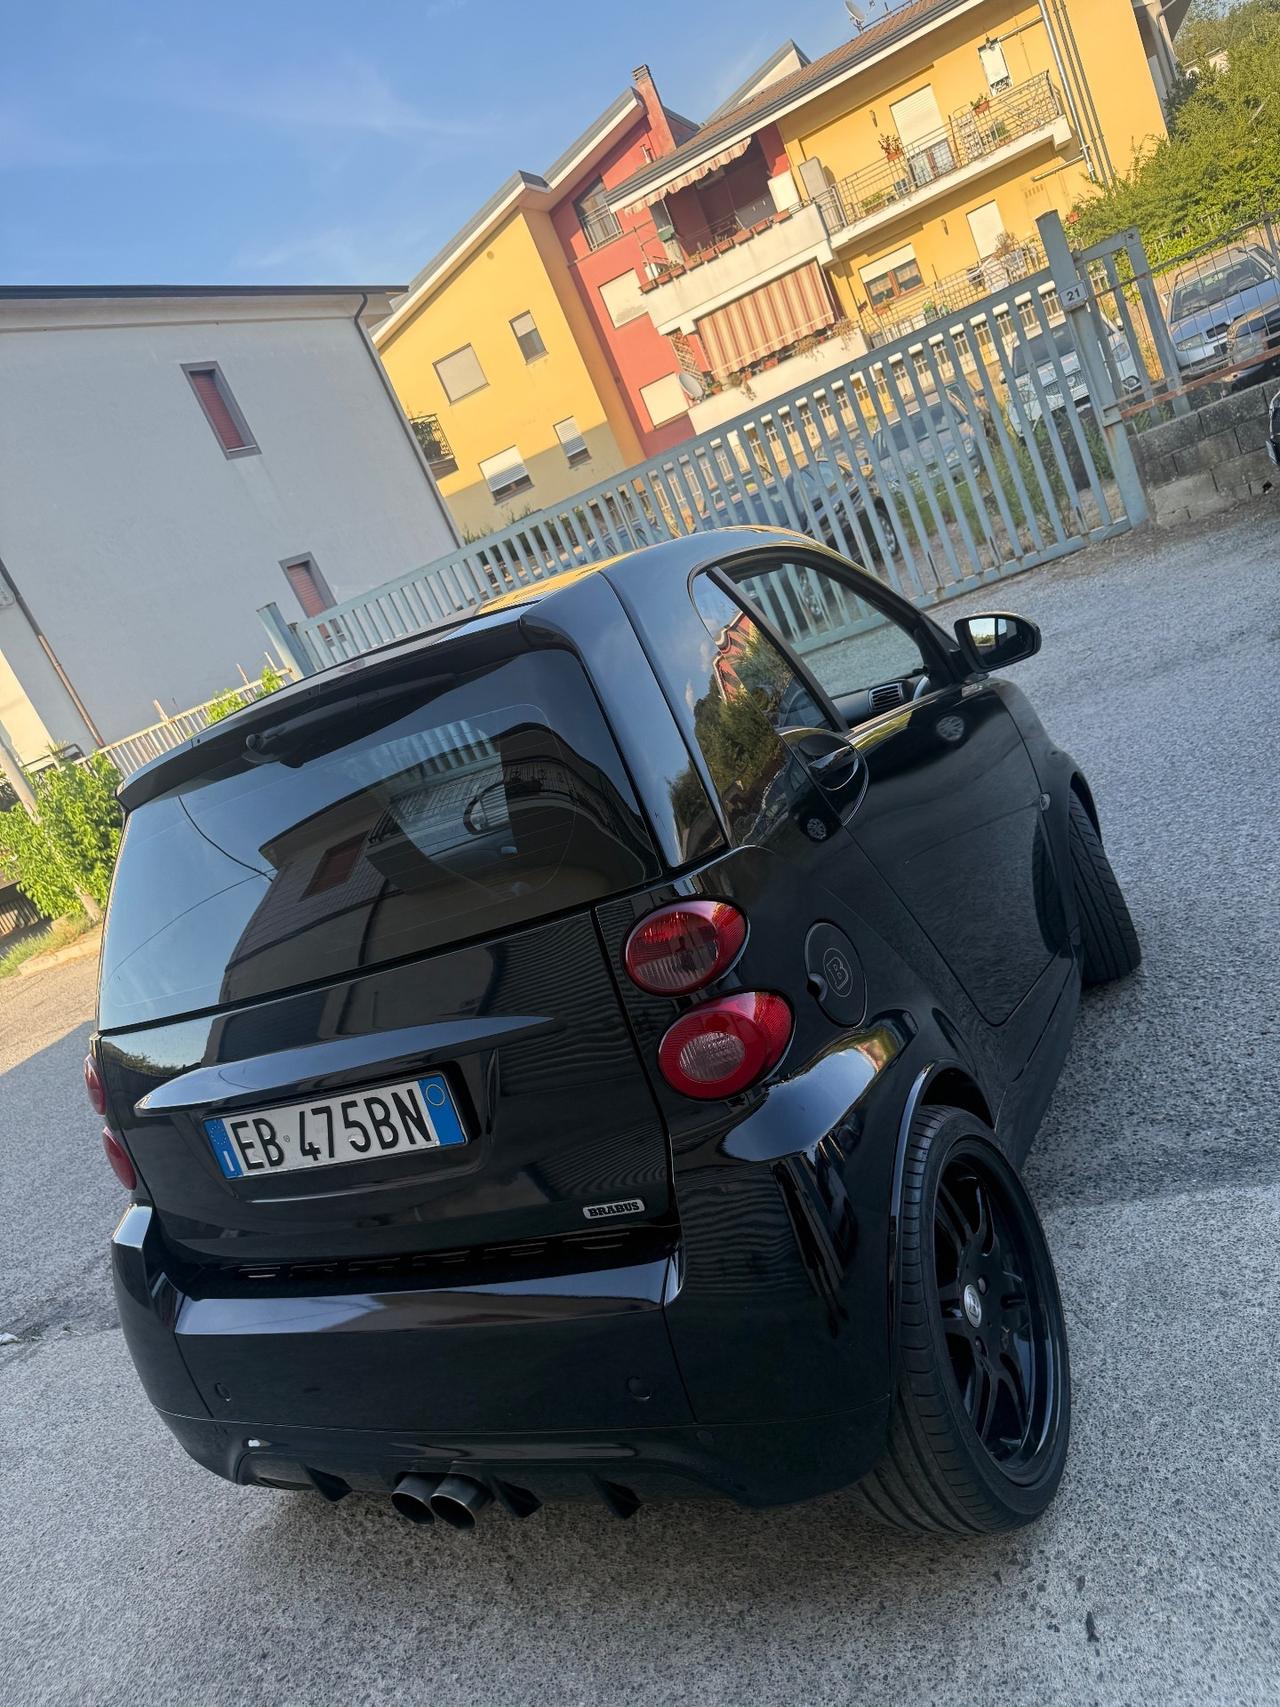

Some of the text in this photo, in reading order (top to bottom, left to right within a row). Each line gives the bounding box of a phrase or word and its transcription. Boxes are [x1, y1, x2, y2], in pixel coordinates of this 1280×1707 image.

[1066, 287, 1080, 301] 21
[826, 957, 849, 990] B
[230, 1088, 432, 1170] EB 475BN
[588, 1202, 640, 1217] BRABUS
